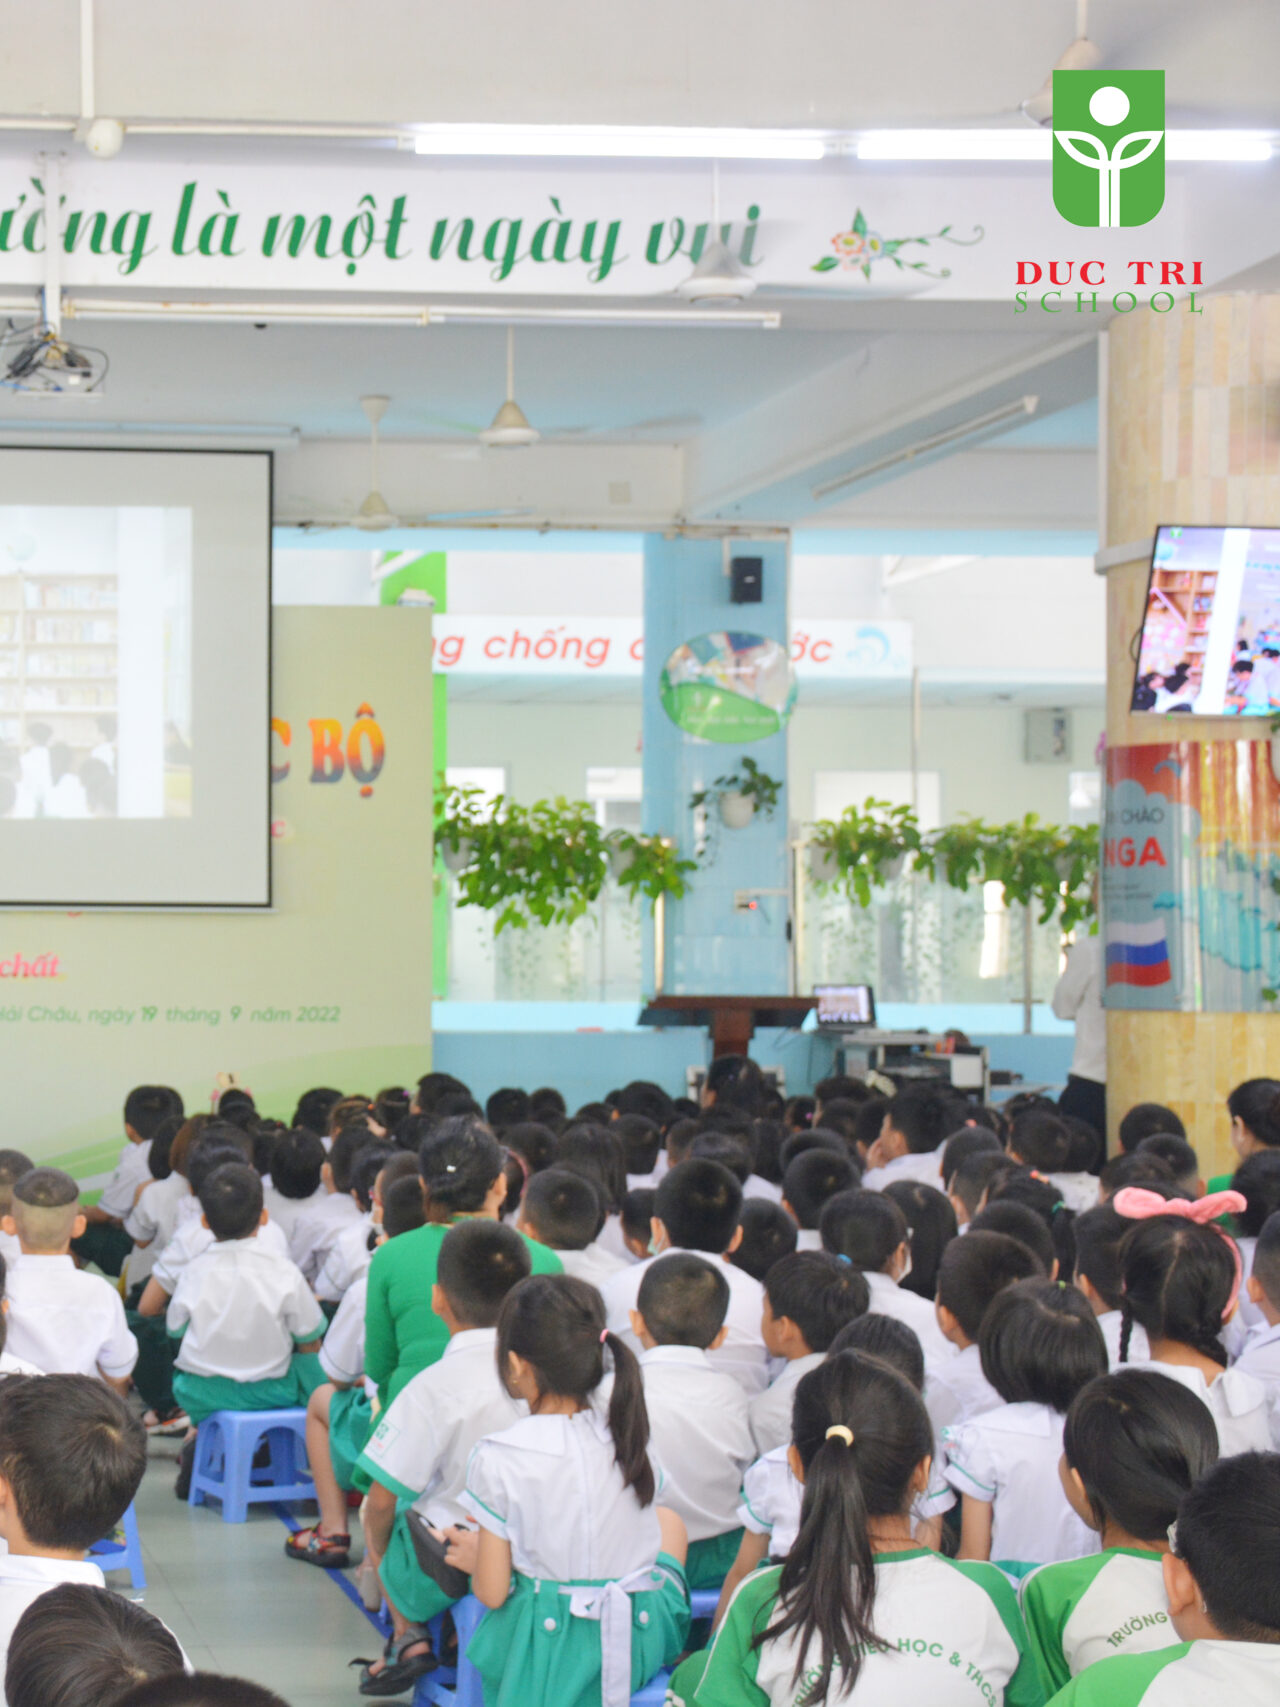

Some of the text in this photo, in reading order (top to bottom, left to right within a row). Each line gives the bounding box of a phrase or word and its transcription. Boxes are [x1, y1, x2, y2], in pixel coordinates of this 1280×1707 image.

[171, 180, 246, 257] là
[261, 193, 413, 276] một
[428, 195, 630, 284] ngày
[483, 625, 611, 668] chống
[307, 701, 386, 799] BỘ
[140, 1005, 158, 1023] 19
[230, 1005, 242, 1023] 9
[295, 1005, 342, 1023] 2022
[897, 1637, 944, 1658] HỌC
[948, 1651, 962, 1667] &
